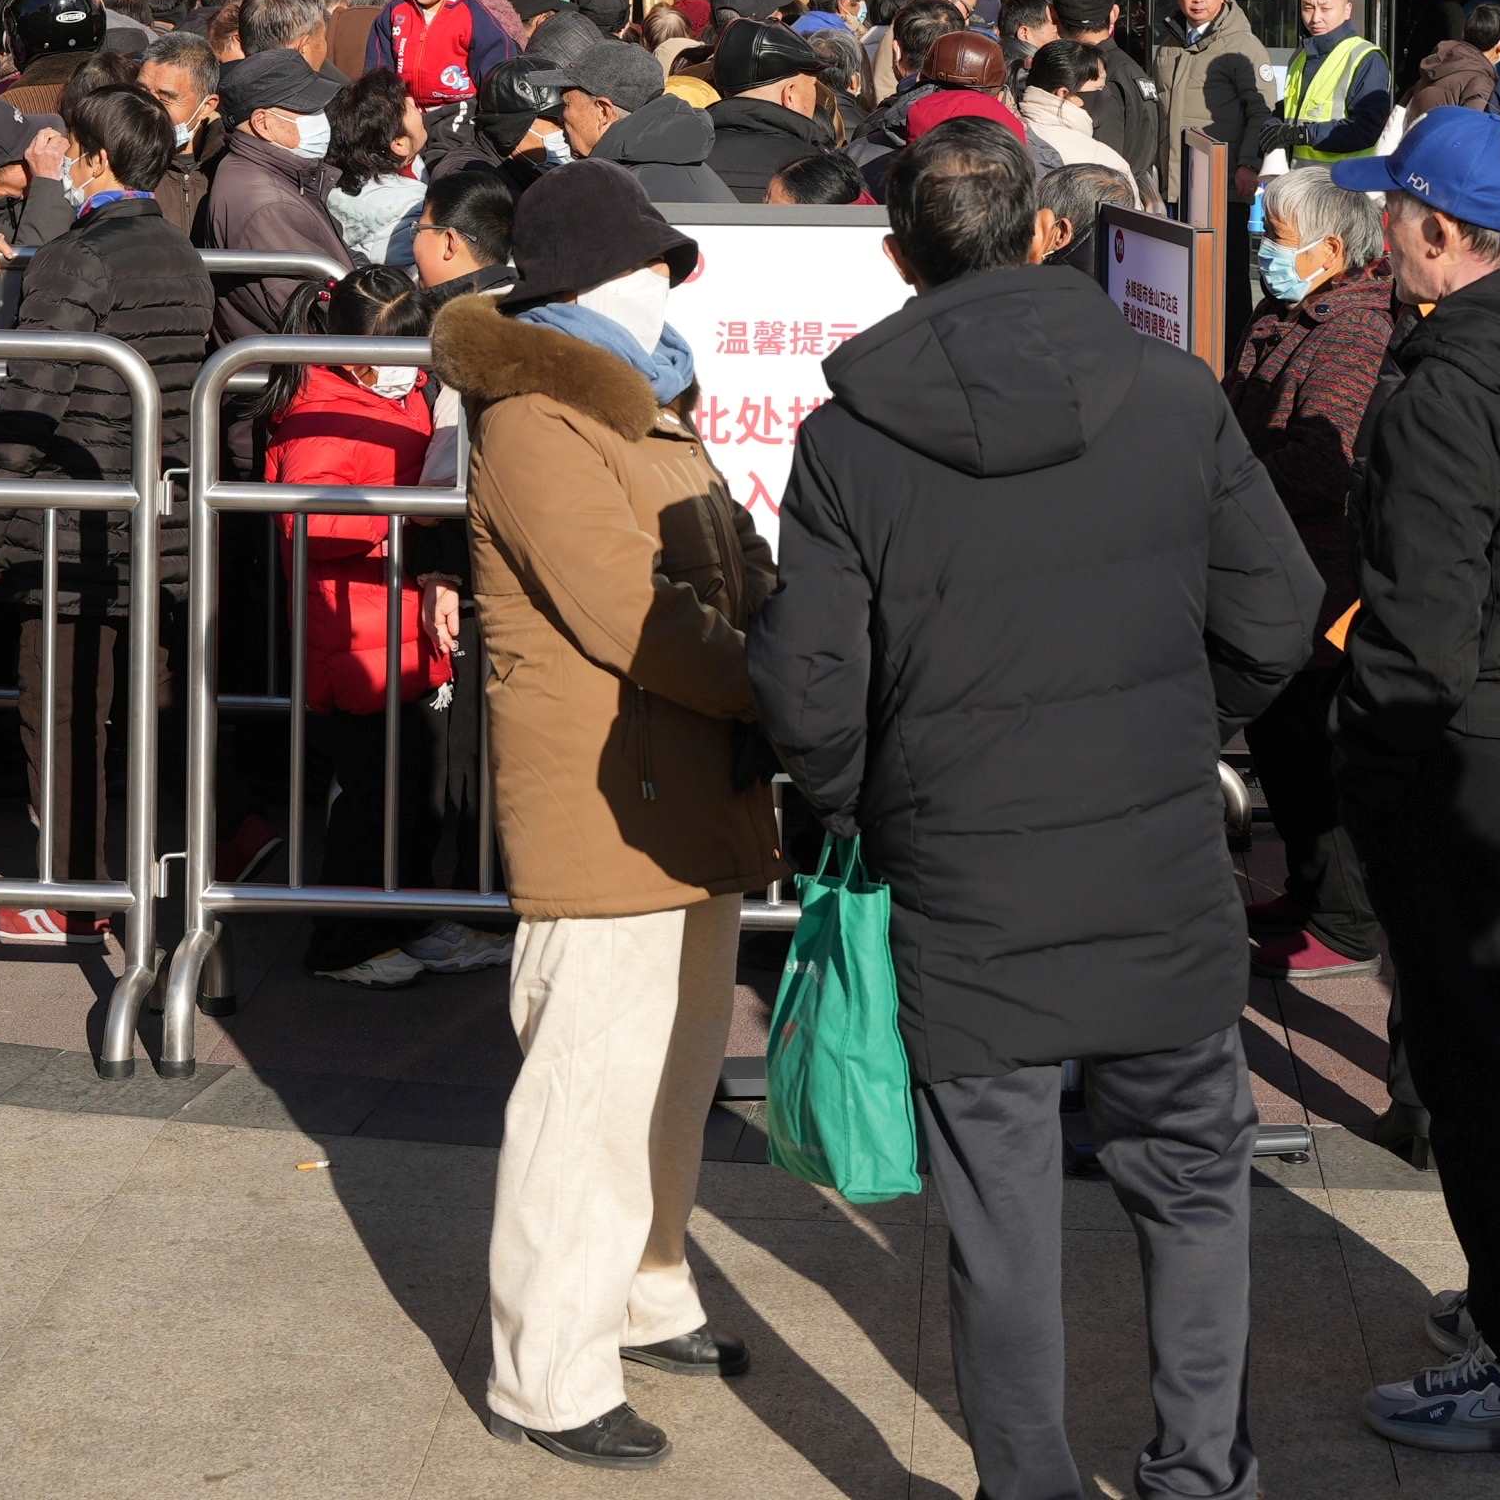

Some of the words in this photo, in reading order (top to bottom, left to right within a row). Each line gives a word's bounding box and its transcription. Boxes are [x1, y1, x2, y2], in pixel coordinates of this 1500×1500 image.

[1125, 277, 1179, 315] 永辉超市金山万达店
[1123, 302, 1181, 346] 营业时间调整公告
